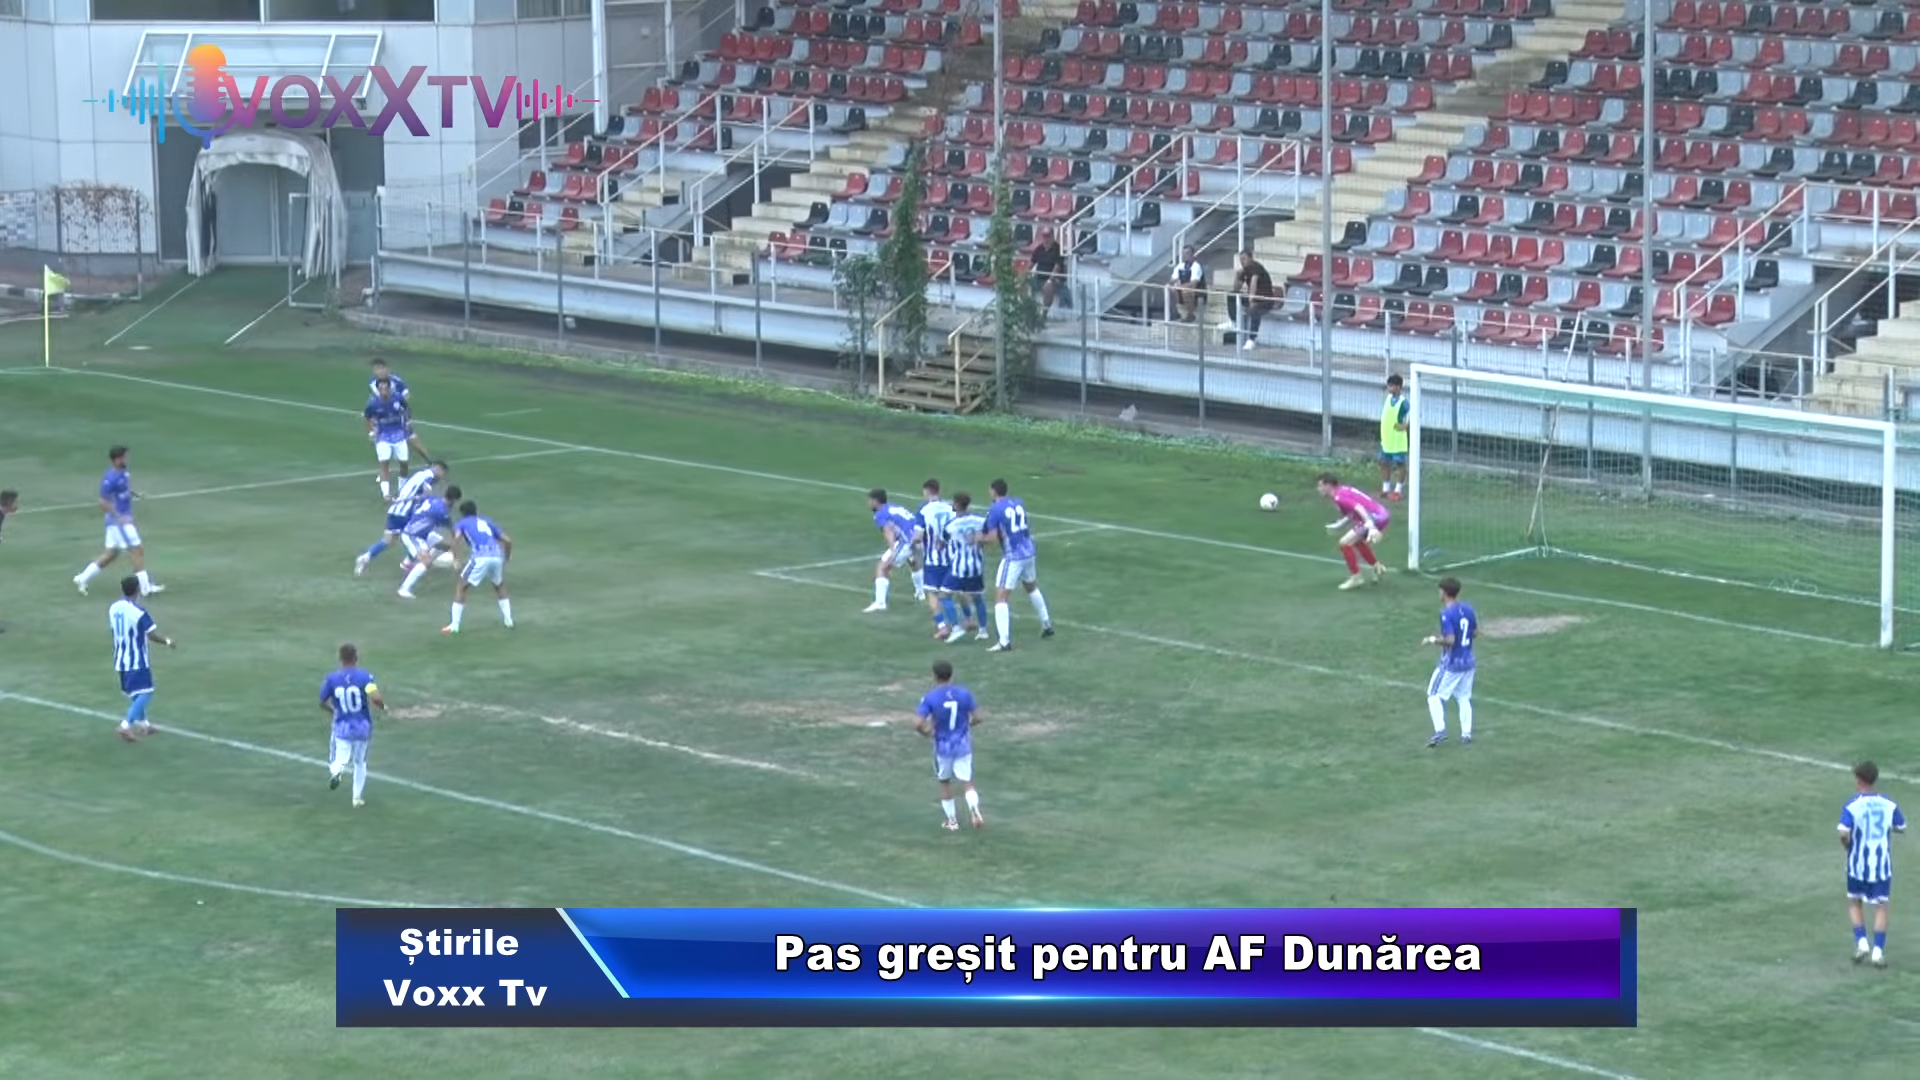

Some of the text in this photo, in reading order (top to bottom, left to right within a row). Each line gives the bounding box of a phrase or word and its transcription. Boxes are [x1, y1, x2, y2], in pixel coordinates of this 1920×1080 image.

[1005, 505, 1027, 533] 22
[1459, 617, 1470, 647] 2
[334, 685, 362, 713] 10
[942, 700, 958, 731] 7
[1862, 809, 1885, 840] 13
